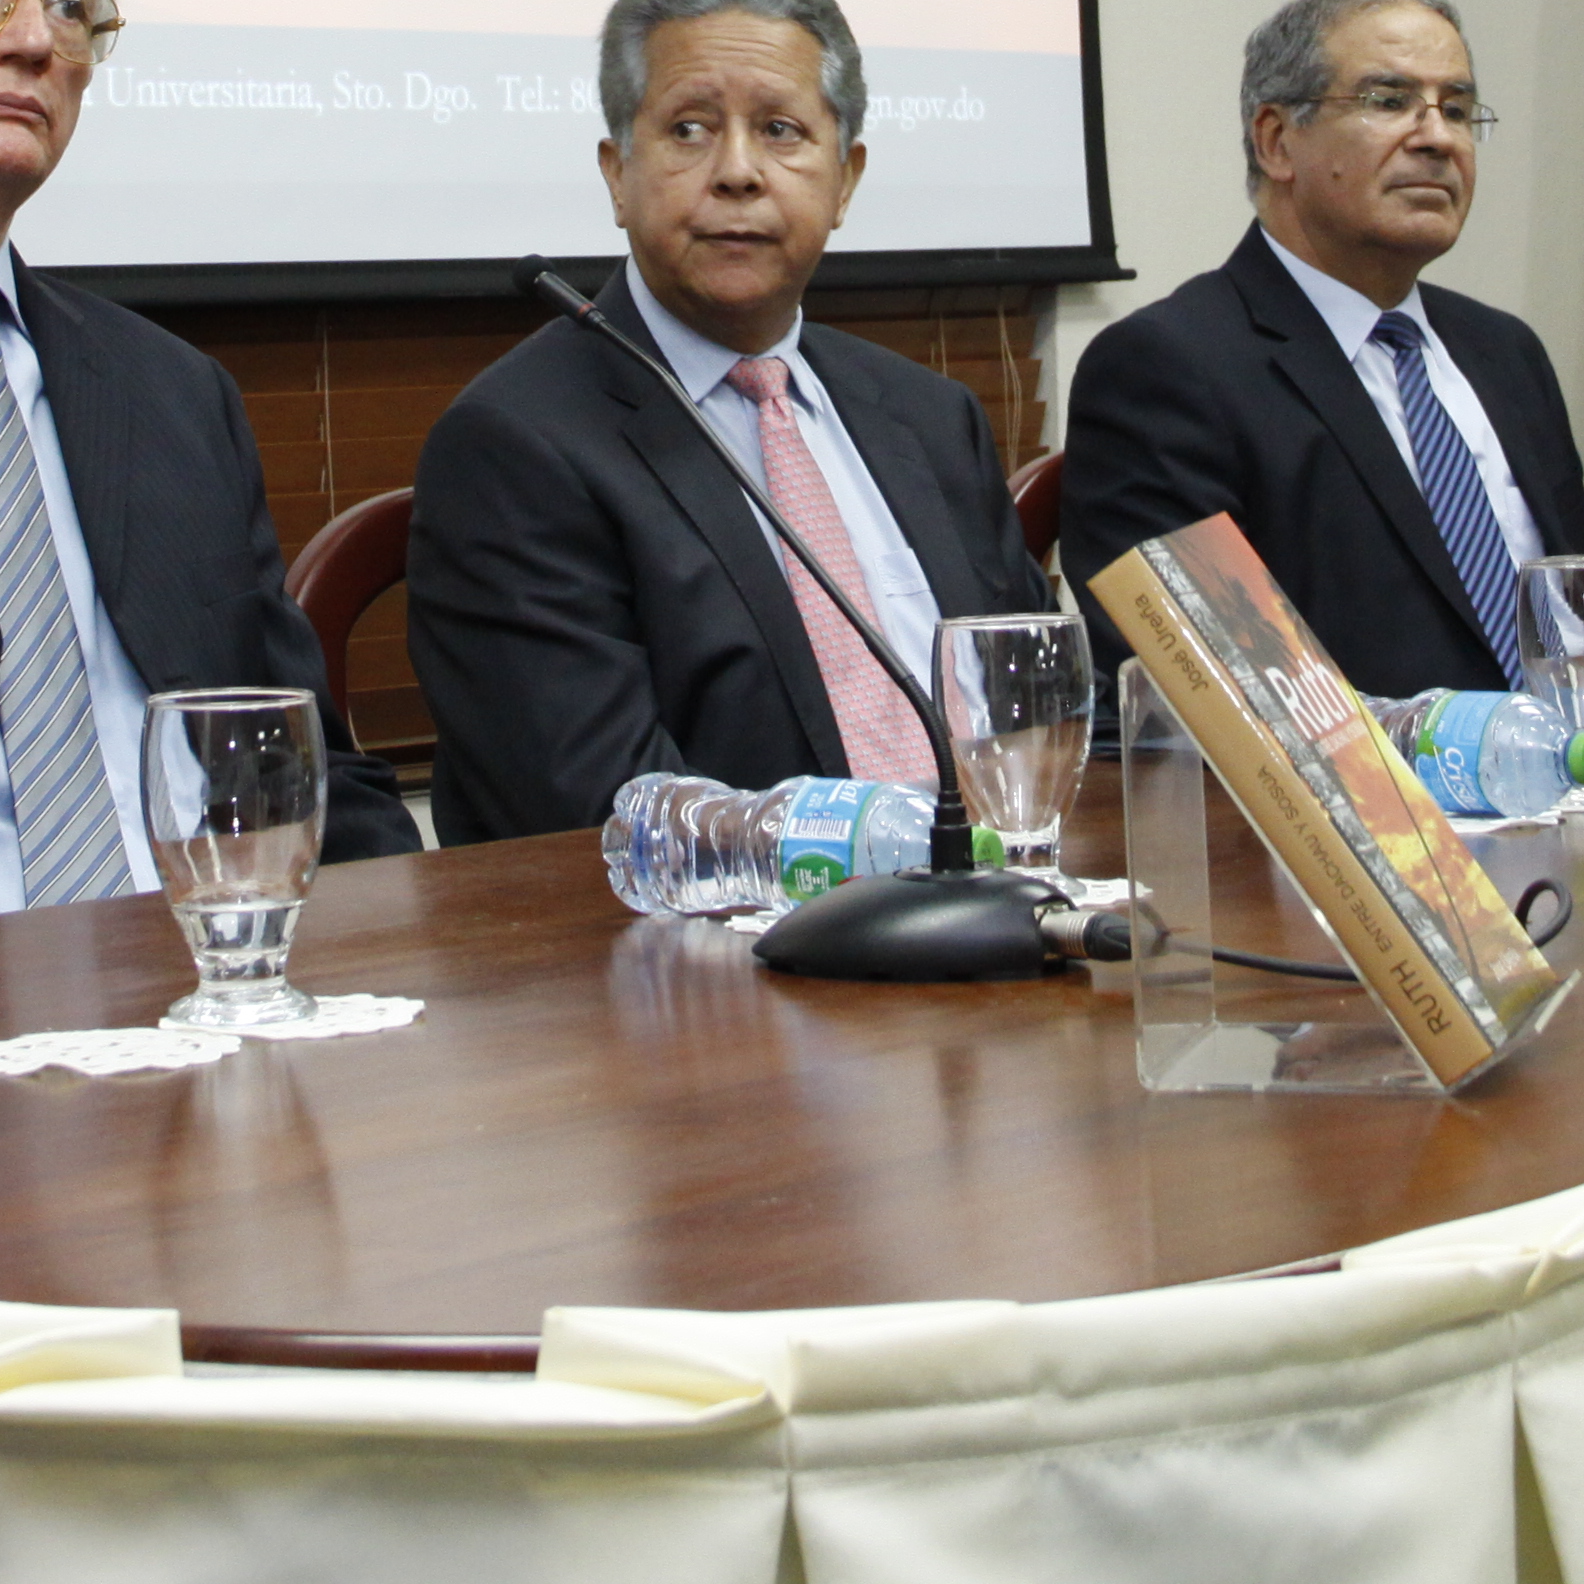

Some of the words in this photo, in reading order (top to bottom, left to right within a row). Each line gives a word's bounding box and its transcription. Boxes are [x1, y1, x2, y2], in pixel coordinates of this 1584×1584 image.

[105, 66, 324, 117] Universitaria,
[332, 70, 392, 111] Sto.
[404, 71, 477, 125] Dgo.
[497, 73, 559, 113] Tel.:
[1135, 592, 1179, 653] Ureña
[1171, 648, 1211, 695] José
[1264, 650, 1352, 741] Ruth
[1303, 835, 1356, 901] DACHAU
[1351, 900, 1393, 953] ENTRE
[1390, 958, 1452, 1037] RUTH
